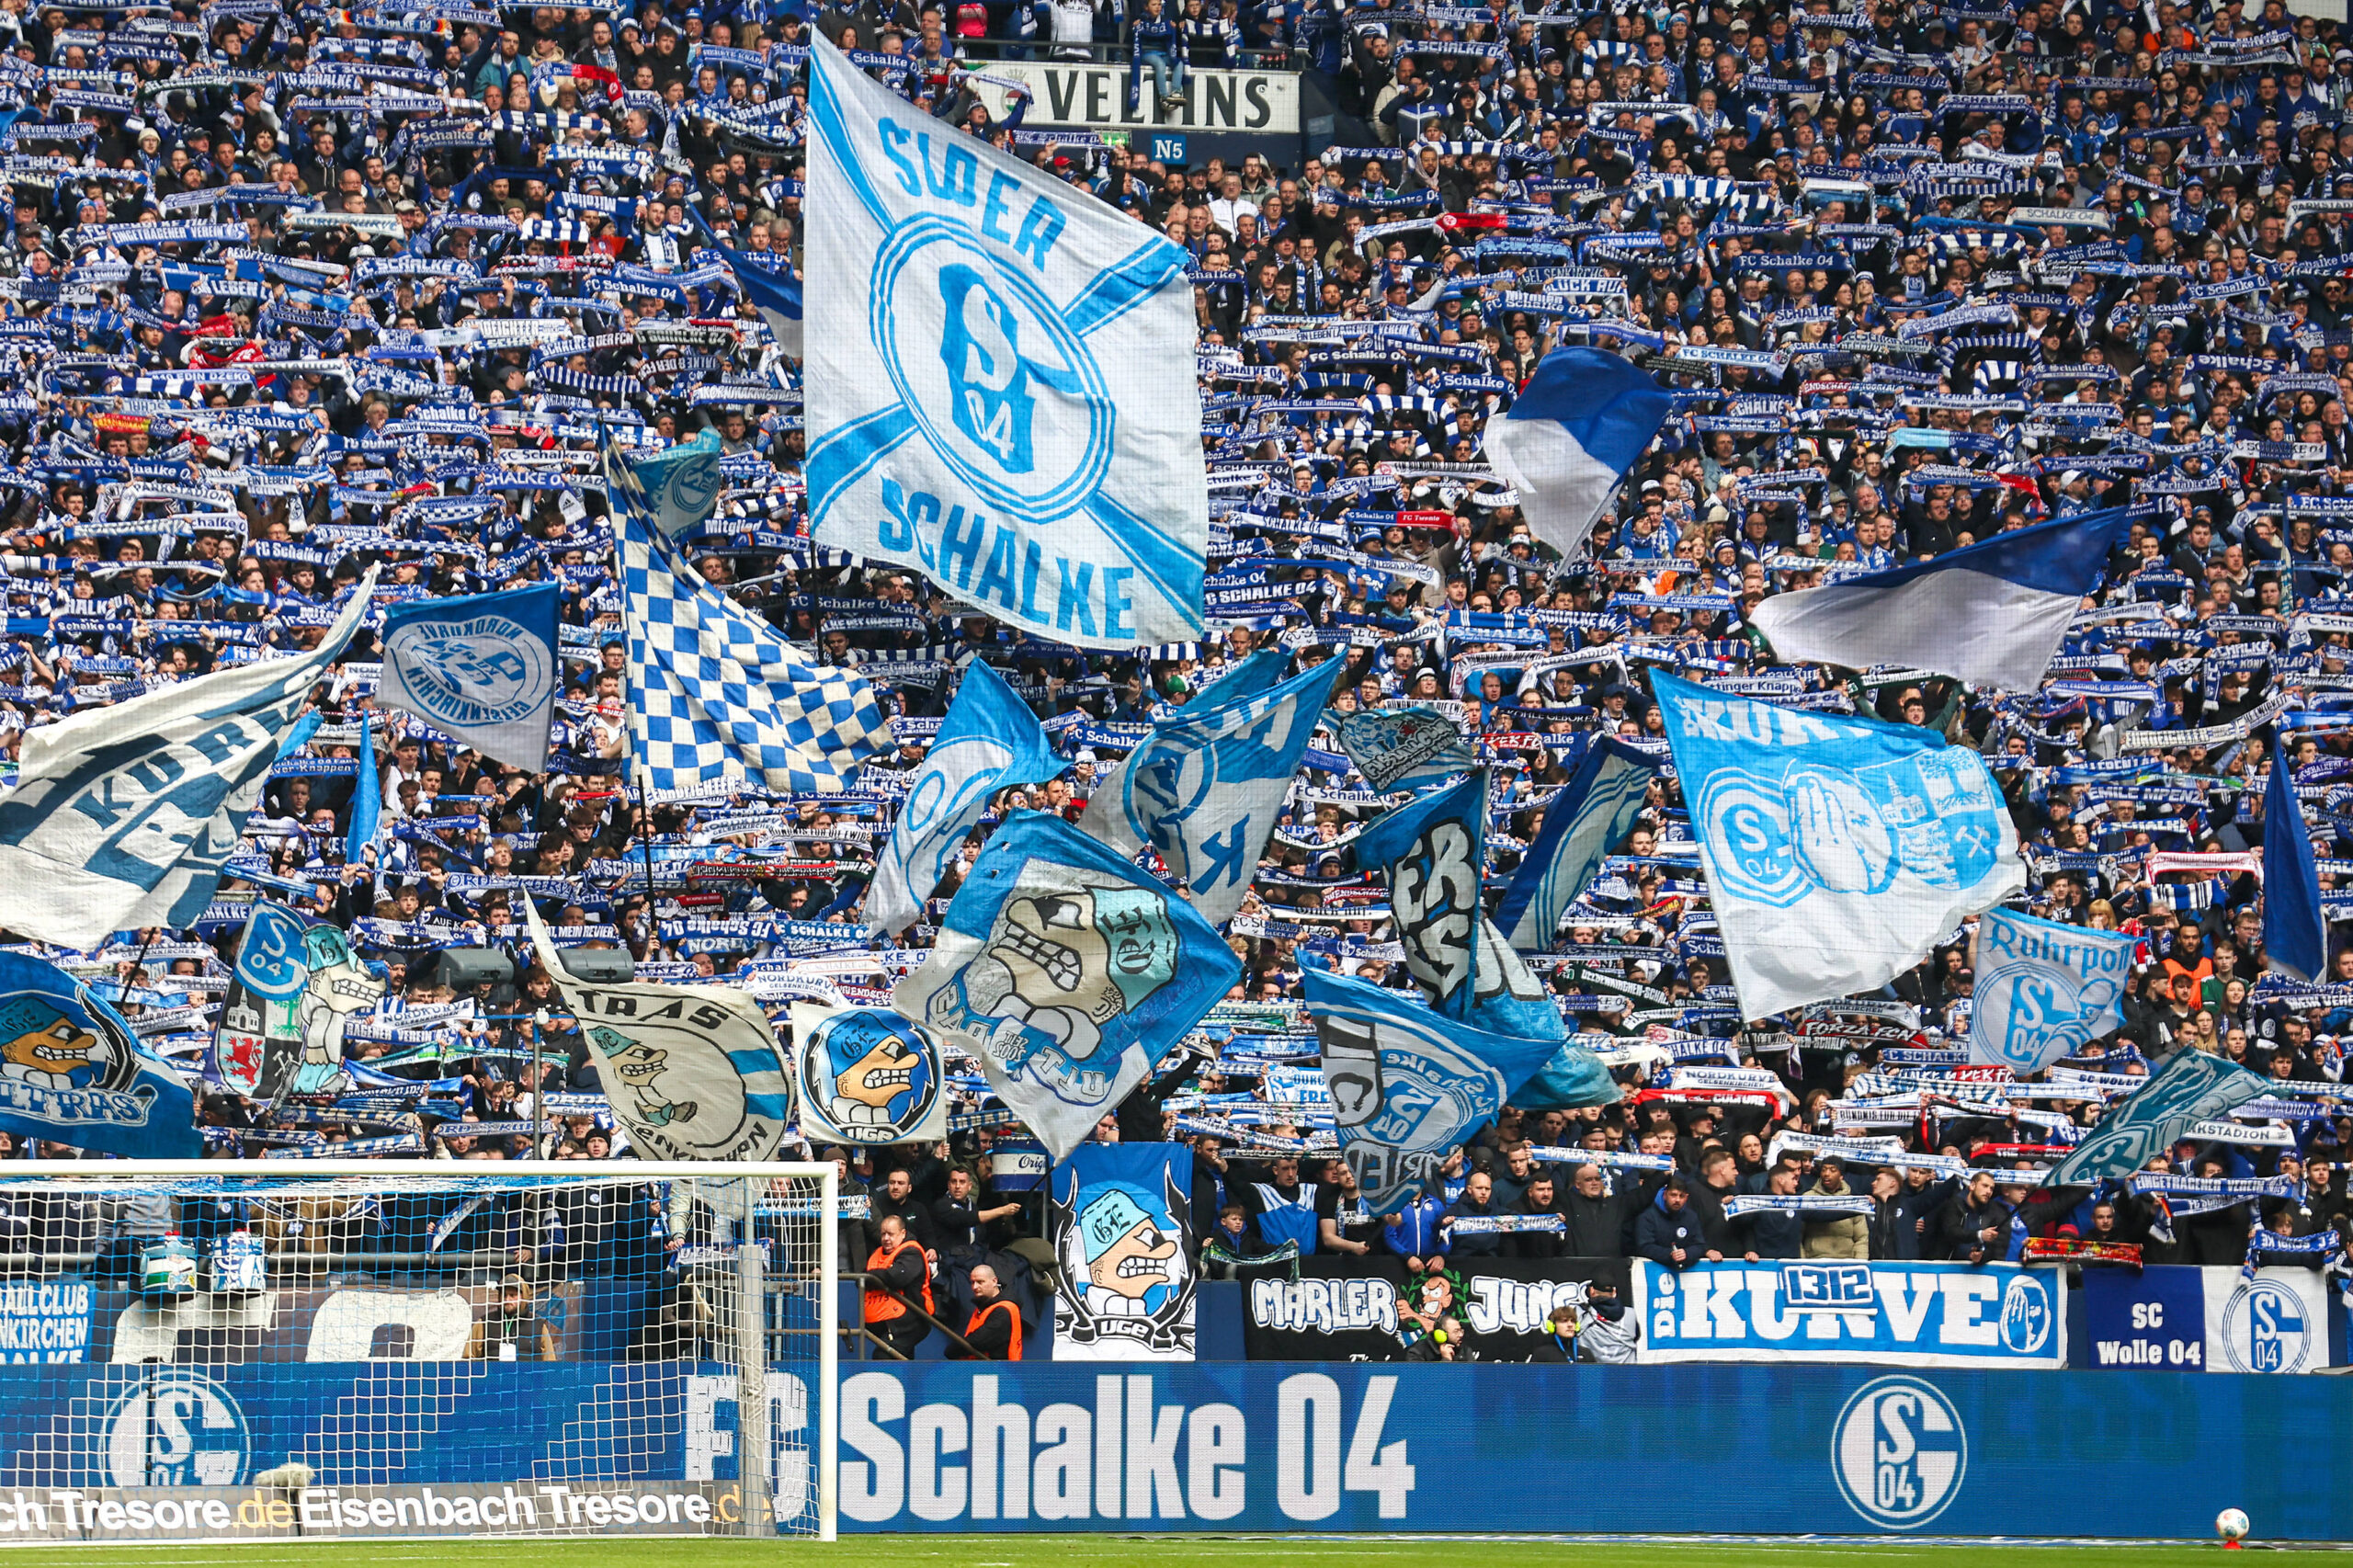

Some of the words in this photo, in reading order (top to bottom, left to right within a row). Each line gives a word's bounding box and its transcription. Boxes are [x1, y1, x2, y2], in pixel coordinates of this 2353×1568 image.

[1154, 138, 1183, 159] N5
[1741, 256, 1755, 266] FC
[1760, 255, 1813, 266] Schalke
[1816, 256, 1834, 266] 04
[604, 280, 656, 295] Schalke
[660, 288, 676, 299] 04
[1331, 350, 1385, 361] Schalke
[1443, 375, 1504, 389] Schalke
[878, 475, 1136, 640] SCHALKE
[1296, 583, 1316, 593] 04
[2131, 1303, 2162, 1329] SC
[2098, 1340, 2162, 1366] Wolle
[2168, 1340, 2202, 1365] 04
[839, 1372, 1245, 1523] Schalke
[1277, 1373, 1416, 1521] 04
[1877, 1466, 1916, 1509] 04
